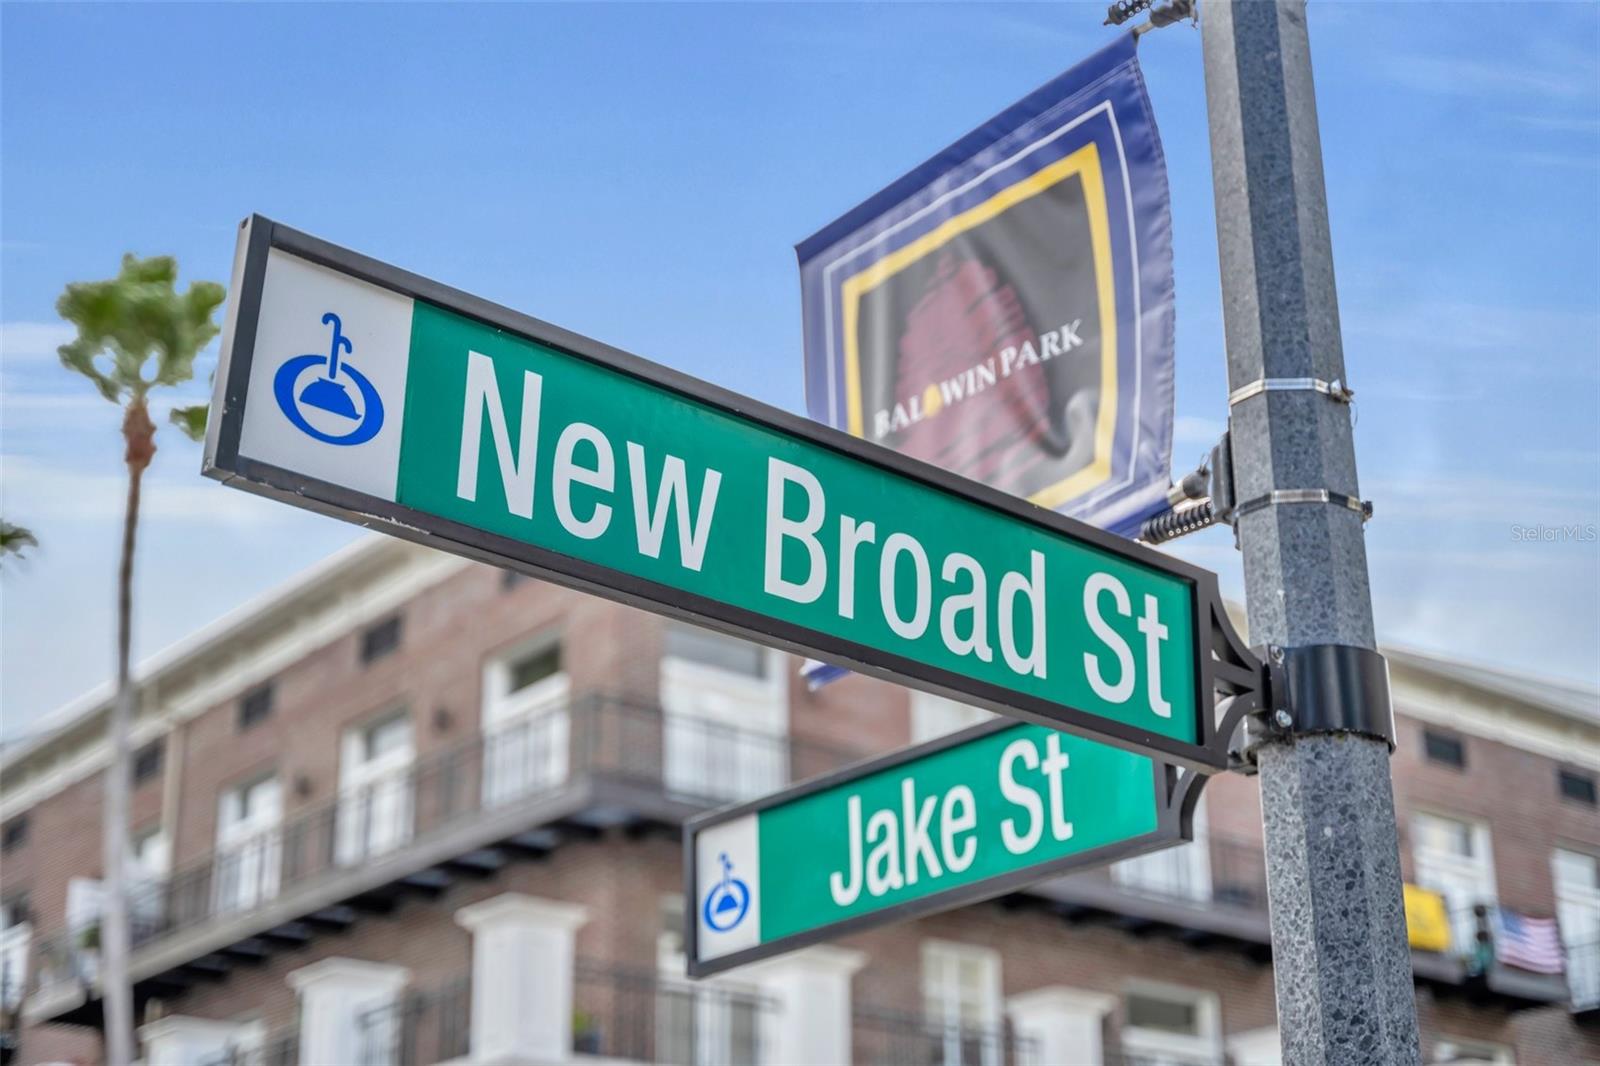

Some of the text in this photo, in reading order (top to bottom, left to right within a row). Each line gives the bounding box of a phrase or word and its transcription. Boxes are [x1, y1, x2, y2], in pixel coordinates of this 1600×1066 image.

[999, 318, 1085, 377] PARK
[456, 350, 1171, 718] New Broad St
[830, 733, 1073, 906] Jake St
